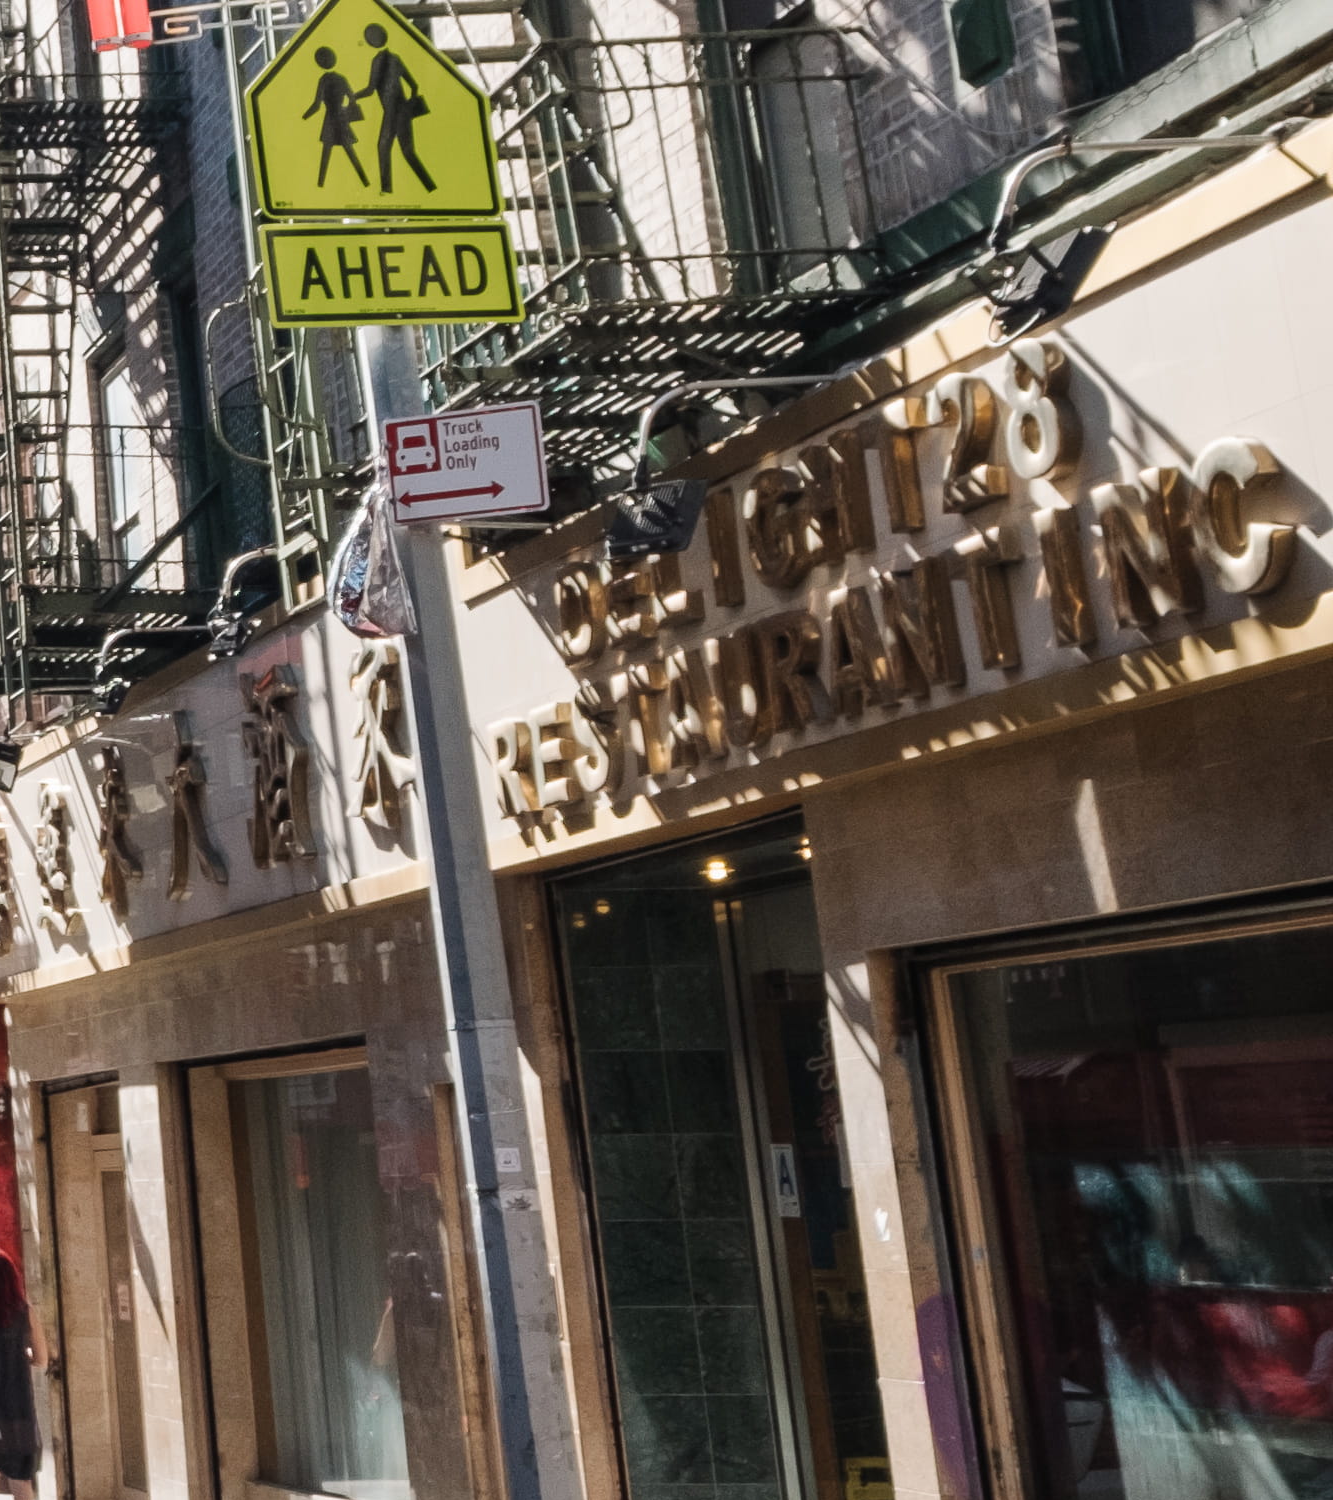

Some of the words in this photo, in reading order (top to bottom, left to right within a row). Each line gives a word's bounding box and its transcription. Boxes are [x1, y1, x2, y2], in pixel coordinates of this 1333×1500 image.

[300, 244, 488, 300] AHEAD
[443, 419, 483, 437] Truck
[444, 435, 500, 453] Loading
[925, 336, 1071, 515] 28
[446, 454, 477, 471] Only
[487, 527, 1021, 822] RESTAURANT
[1031, 437, 1299, 652] INC
[778, 1151, 795, 1197] A
